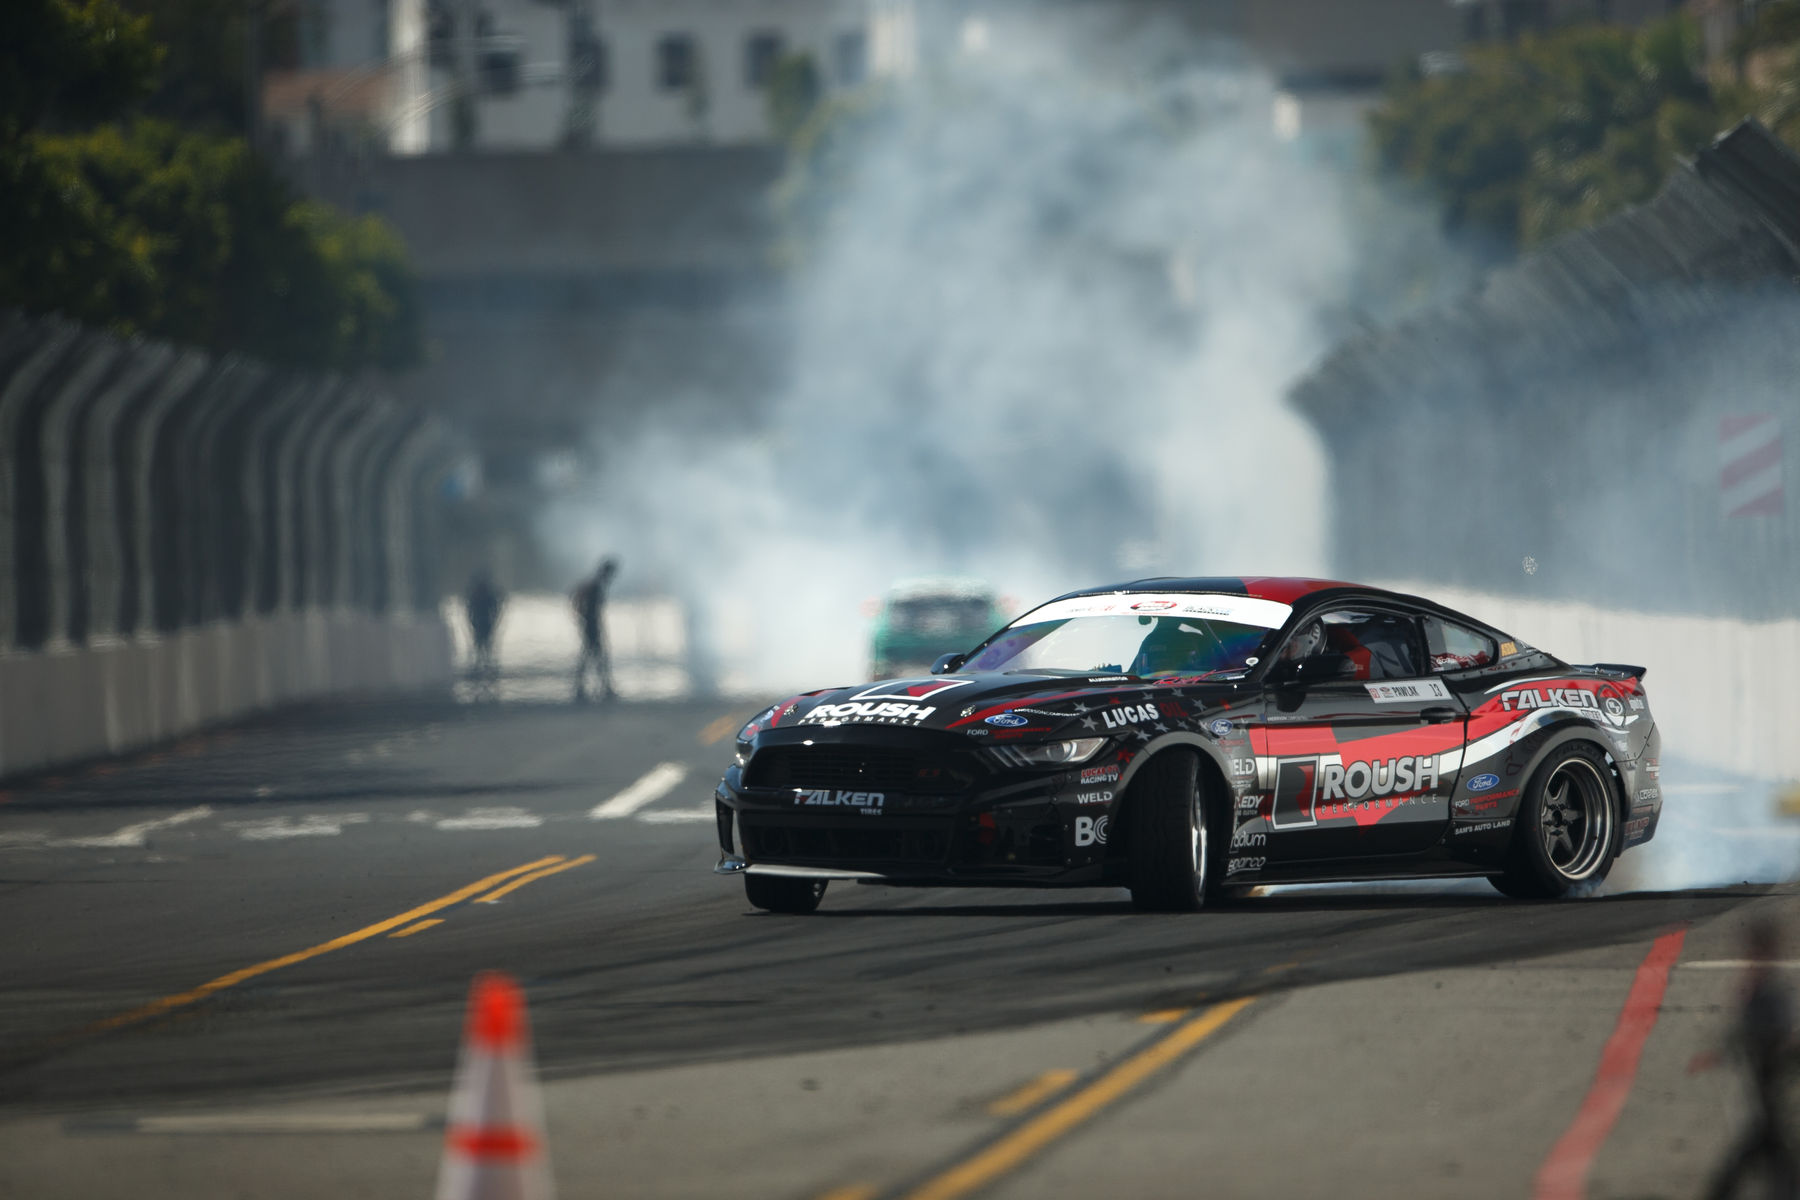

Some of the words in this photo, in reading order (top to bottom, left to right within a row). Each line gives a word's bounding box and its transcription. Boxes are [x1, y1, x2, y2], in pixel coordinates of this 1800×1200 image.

[1393, 685, 1420, 697] PAWLAK
[1429, 683, 1442, 697] 13
[1501, 689, 1600, 711] FALKEN
[804, 702, 936, 720] ROUSH
[991, 713, 1022, 726] Ford
[1102, 703, 1160, 729] LUCAS
[1161, 702, 1189, 718] OIL
[1231, 758, 1256, 776] ELD
[1081, 776, 1107, 785] RACING
[1108, 773, 1119, 782] TV
[1322, 755, 1440, 801] ROUSH
[793, 789, 885, 807] FALKEN
[1077, 792, 1113, 805] WELD
[1321, 793, 1438, 814] PERFORMANCE
[1455, 799, 1469, 808] FORD
[860, 808, 882, 816] TIRES
[1455, 826, 1473, 836] SAM'S
[1474, 823, 1492, 832] AUTO
[1493, 819, 1511, 829] LAND
